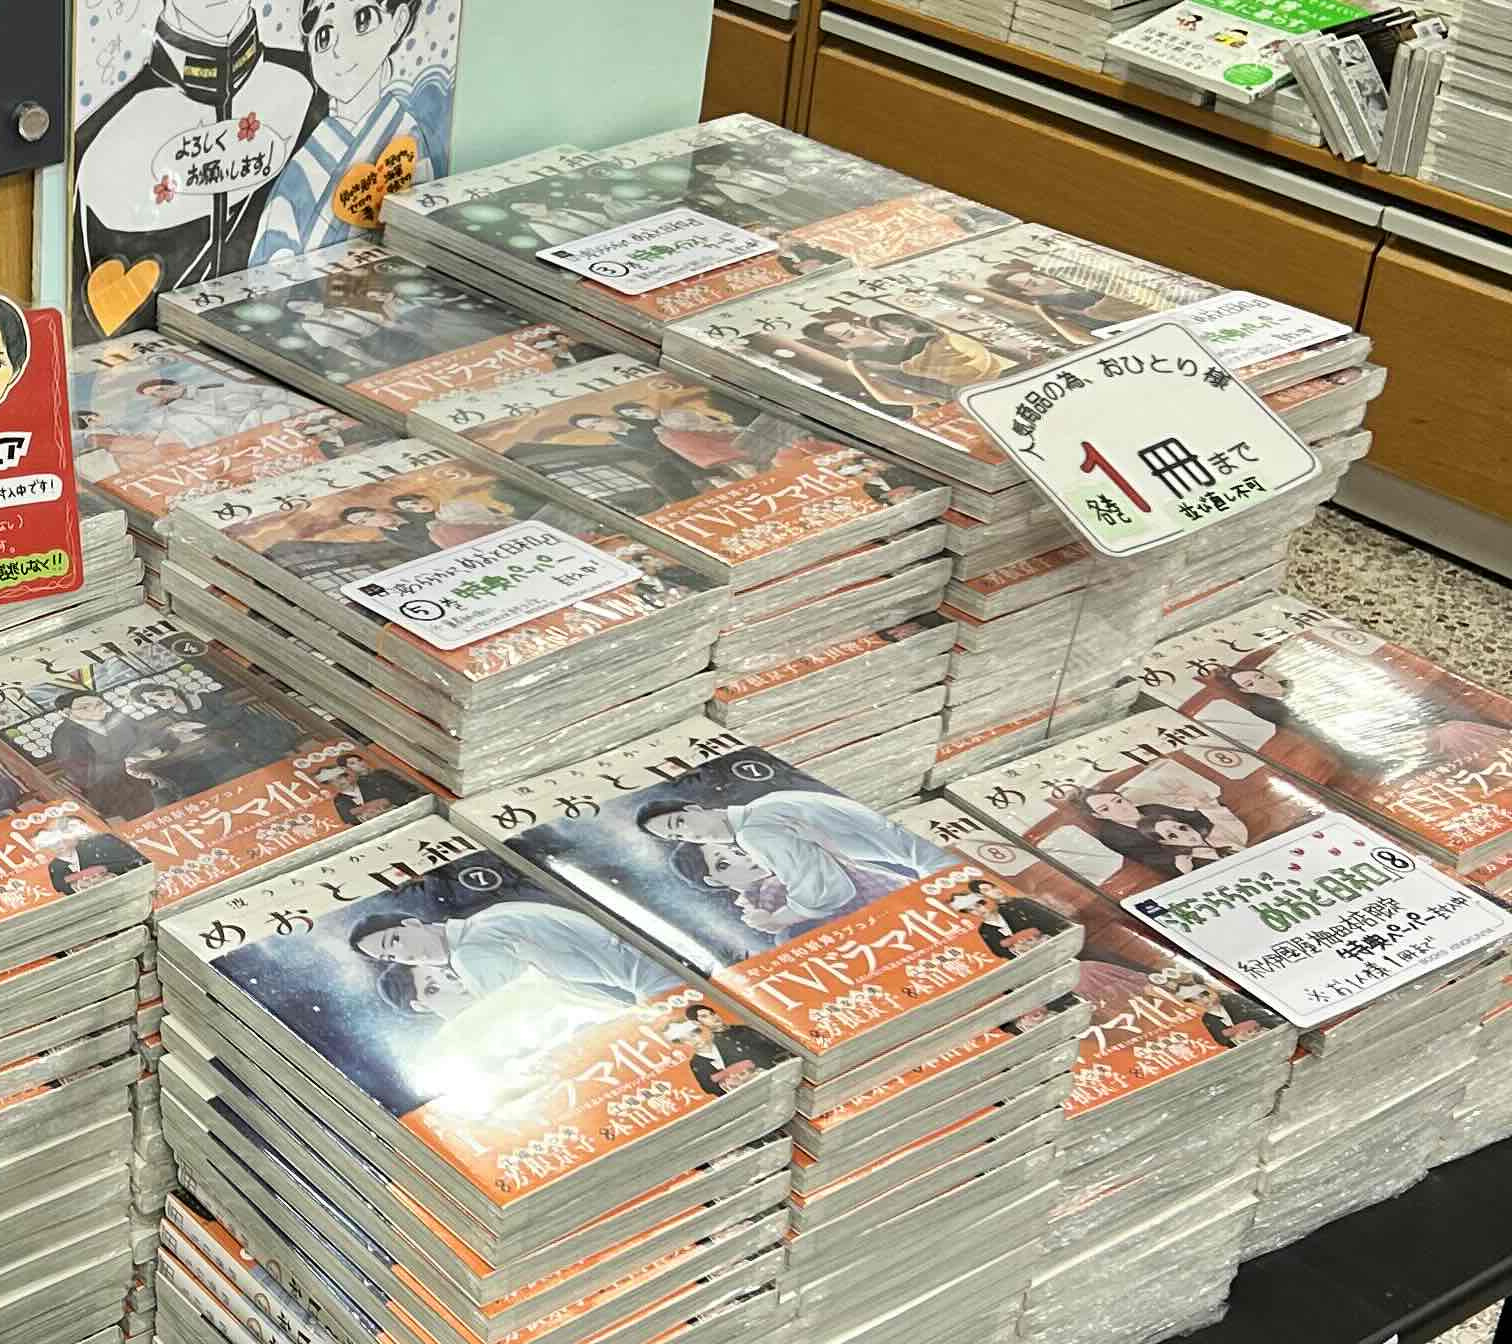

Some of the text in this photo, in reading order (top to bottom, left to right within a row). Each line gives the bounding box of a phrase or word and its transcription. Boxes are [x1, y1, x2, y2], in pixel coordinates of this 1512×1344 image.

[173, 131, 227, 165] よろしく
[750, 896, 972, 1009] TVドラマ化!
